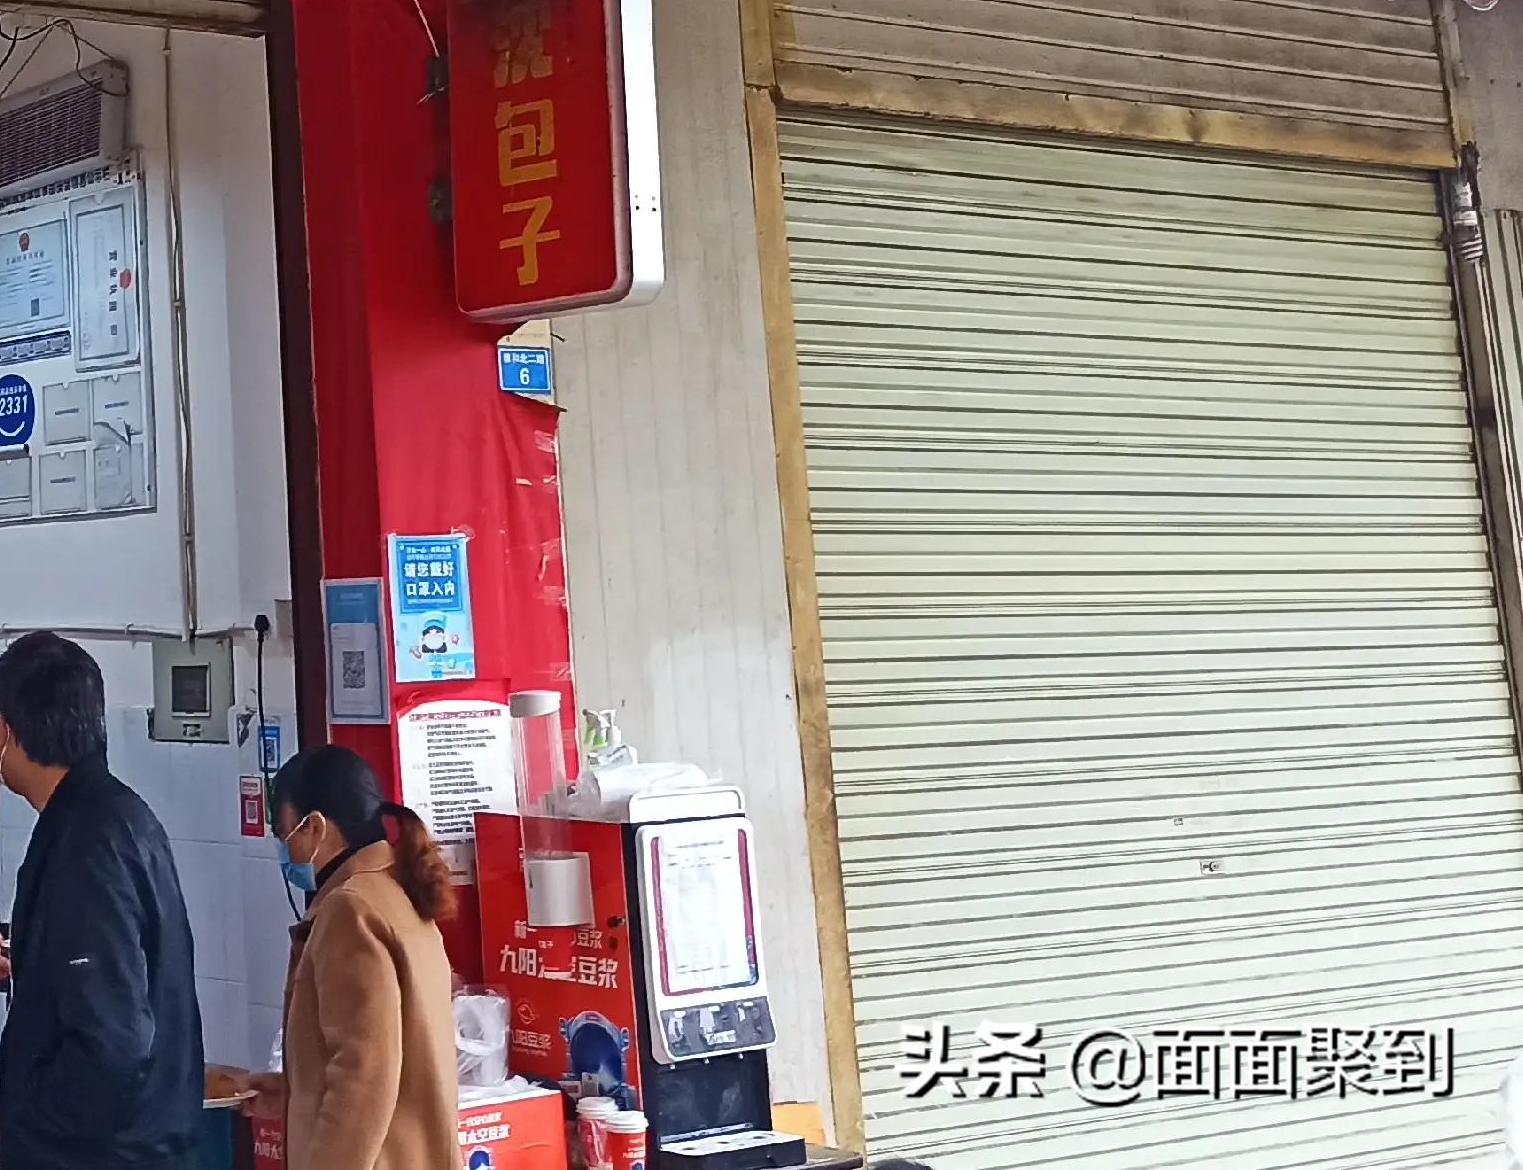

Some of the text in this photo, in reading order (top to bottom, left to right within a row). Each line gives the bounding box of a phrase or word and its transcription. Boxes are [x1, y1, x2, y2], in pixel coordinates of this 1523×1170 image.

[519, 367, 530, 385] 6
[499, 944, 619, 988] 九阳豆浆
